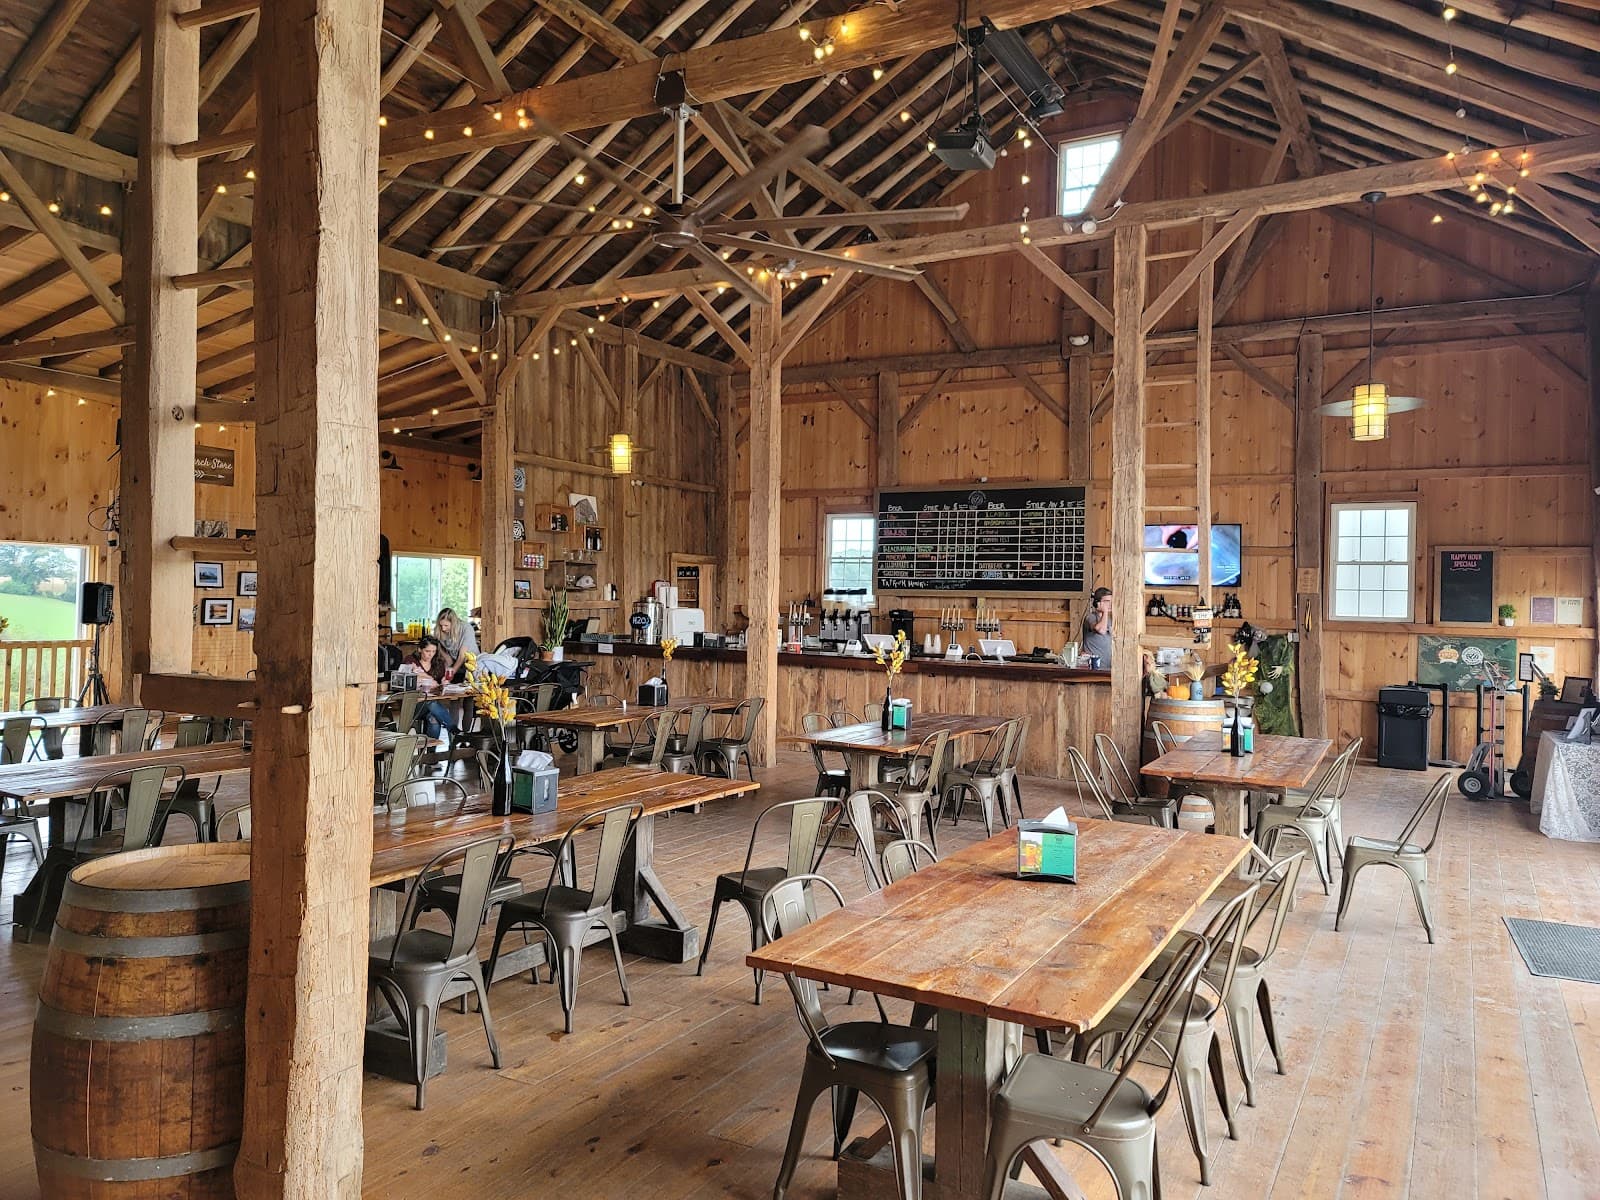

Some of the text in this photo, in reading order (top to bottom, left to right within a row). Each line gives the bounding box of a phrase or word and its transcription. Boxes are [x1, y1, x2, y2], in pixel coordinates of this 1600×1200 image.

[211, 458, 233, 470] Store
[887, 504, 904, 512] BEER
[987, 501, 1006, 510] BEER
[1026, 500, 1047, 509] STYLE
[1454, 560, 1477, 568] SPECIALS
